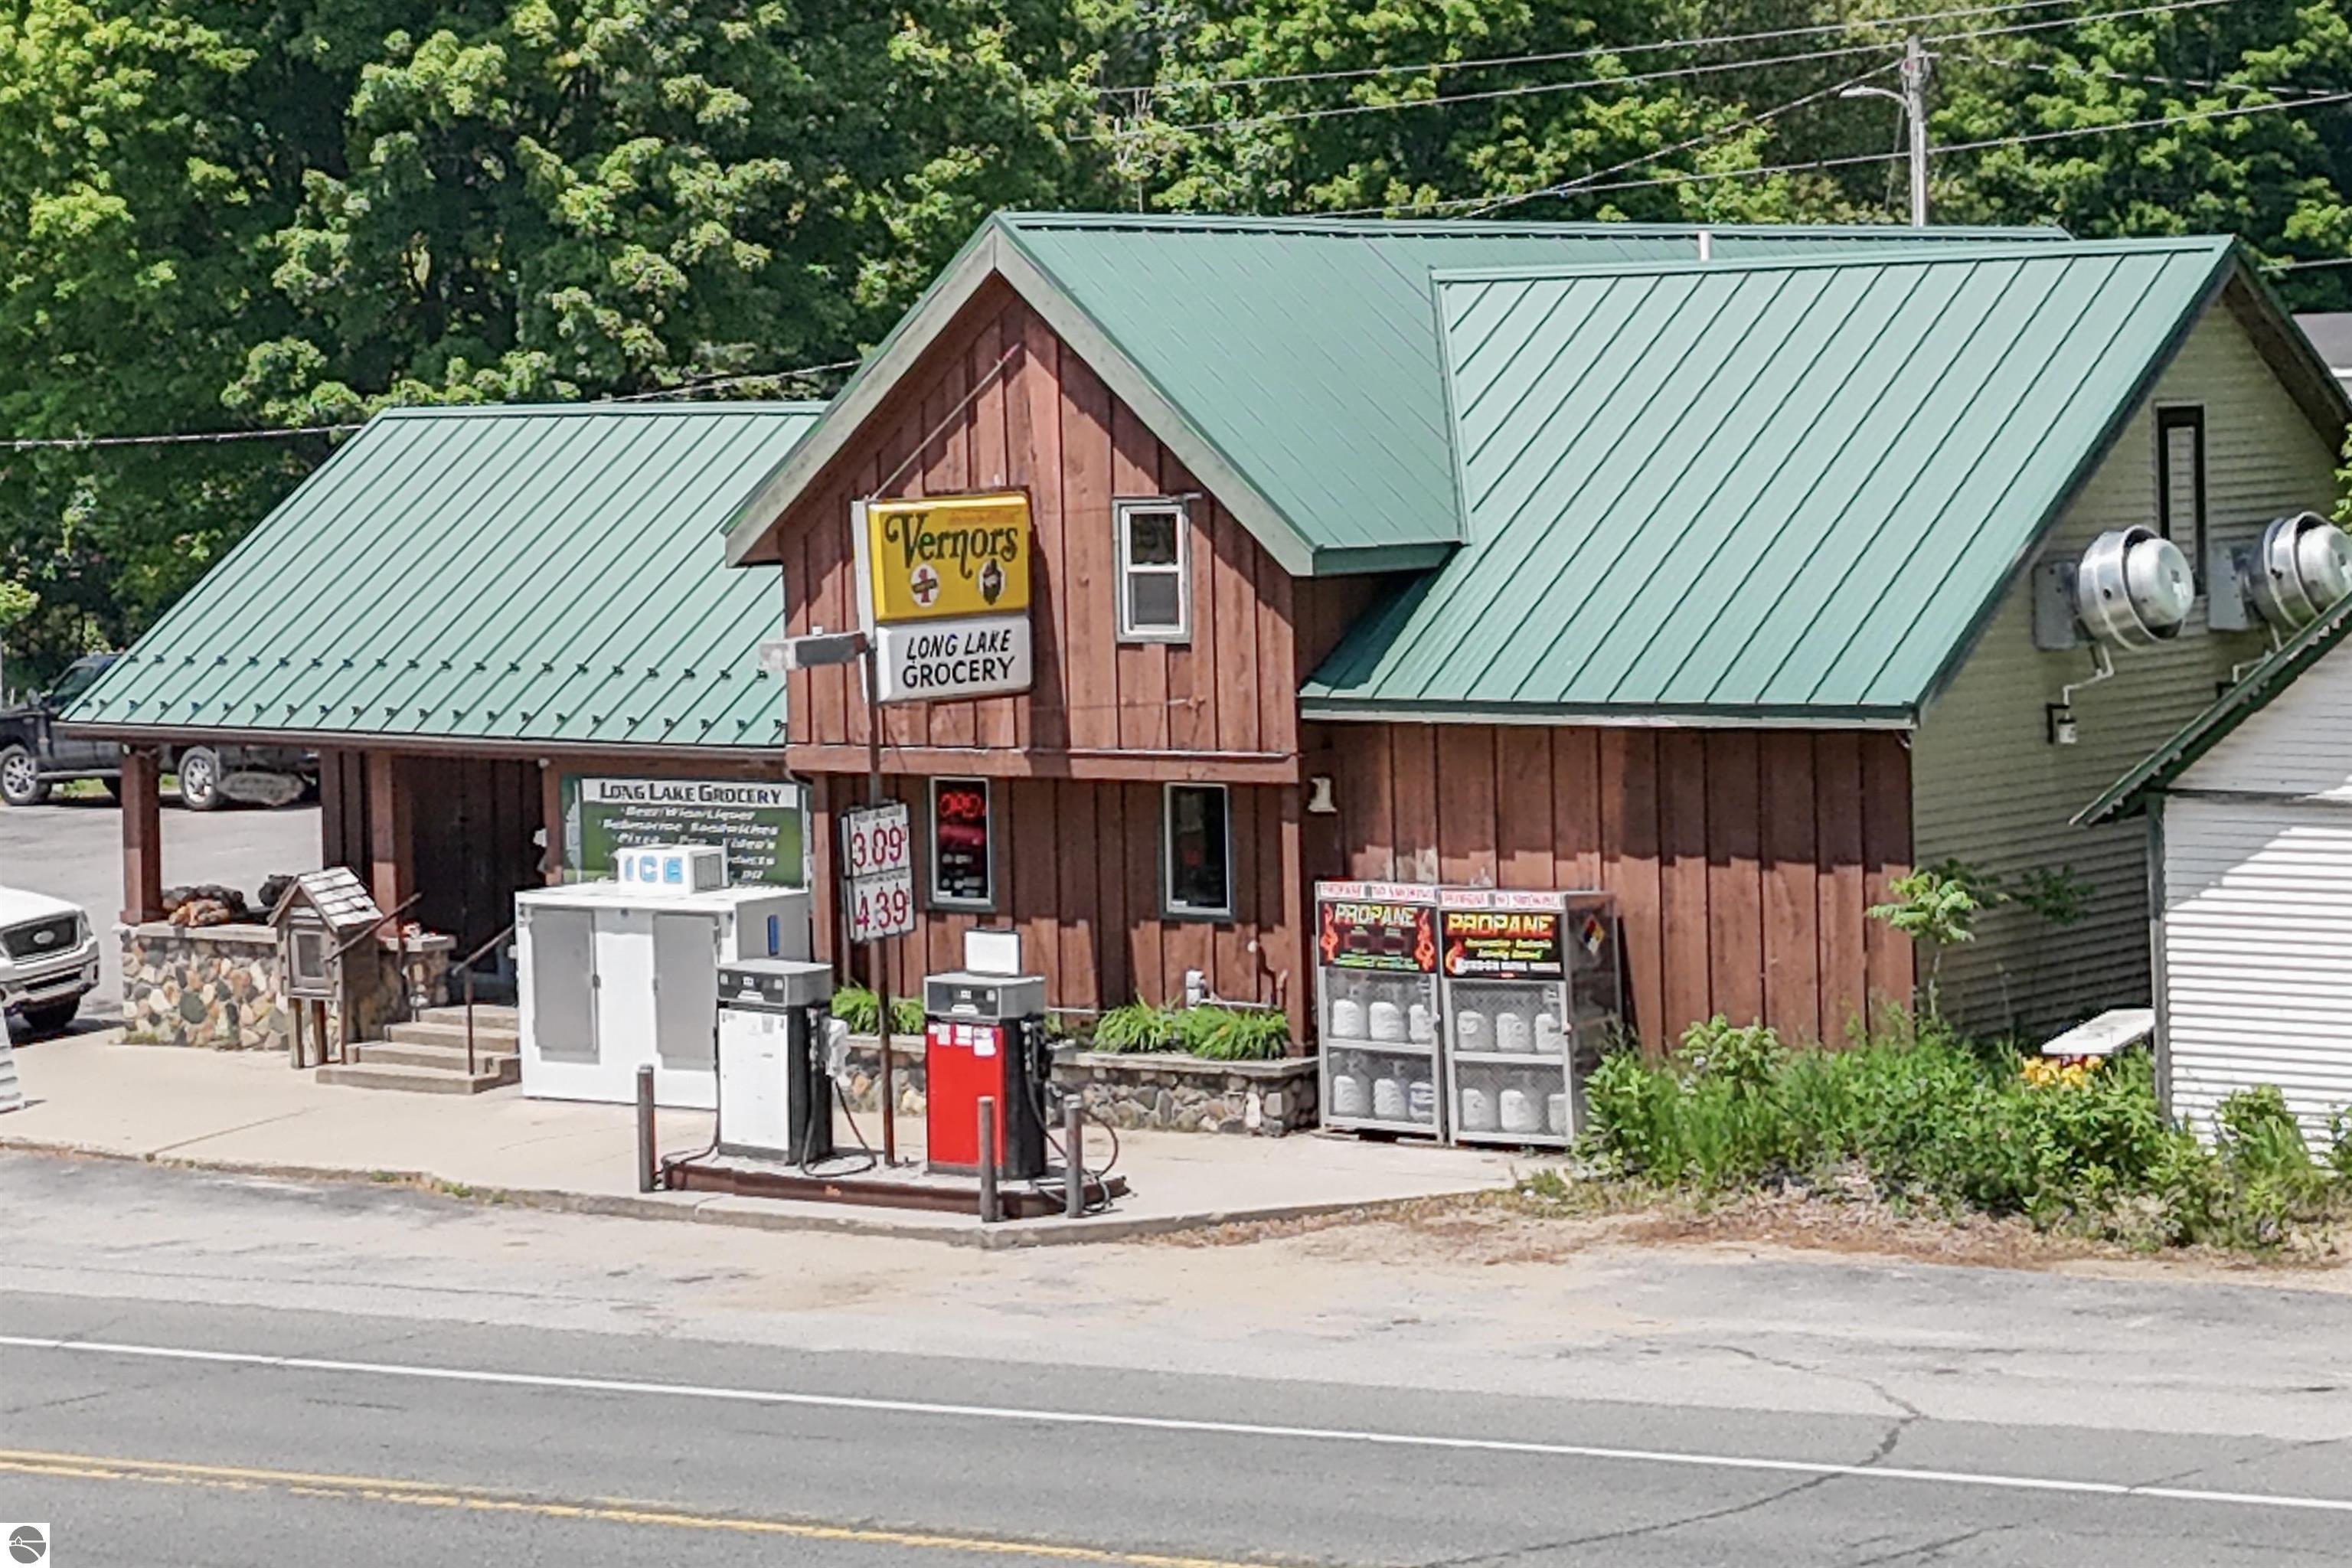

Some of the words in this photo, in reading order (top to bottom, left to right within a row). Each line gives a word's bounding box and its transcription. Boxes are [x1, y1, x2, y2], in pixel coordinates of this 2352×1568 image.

[885, 513, 1018, 580] Vernors
[906, 633, 959, 661] LONG
[965, 629, 1011, 656] LAKE
[903, 655, 1016, 688] GROCERY
[624, 854, 684, 884] ICE
[1334, 903, 1418, 927] PROPANE
[1446, 913, 1555, 937] PROPANE
